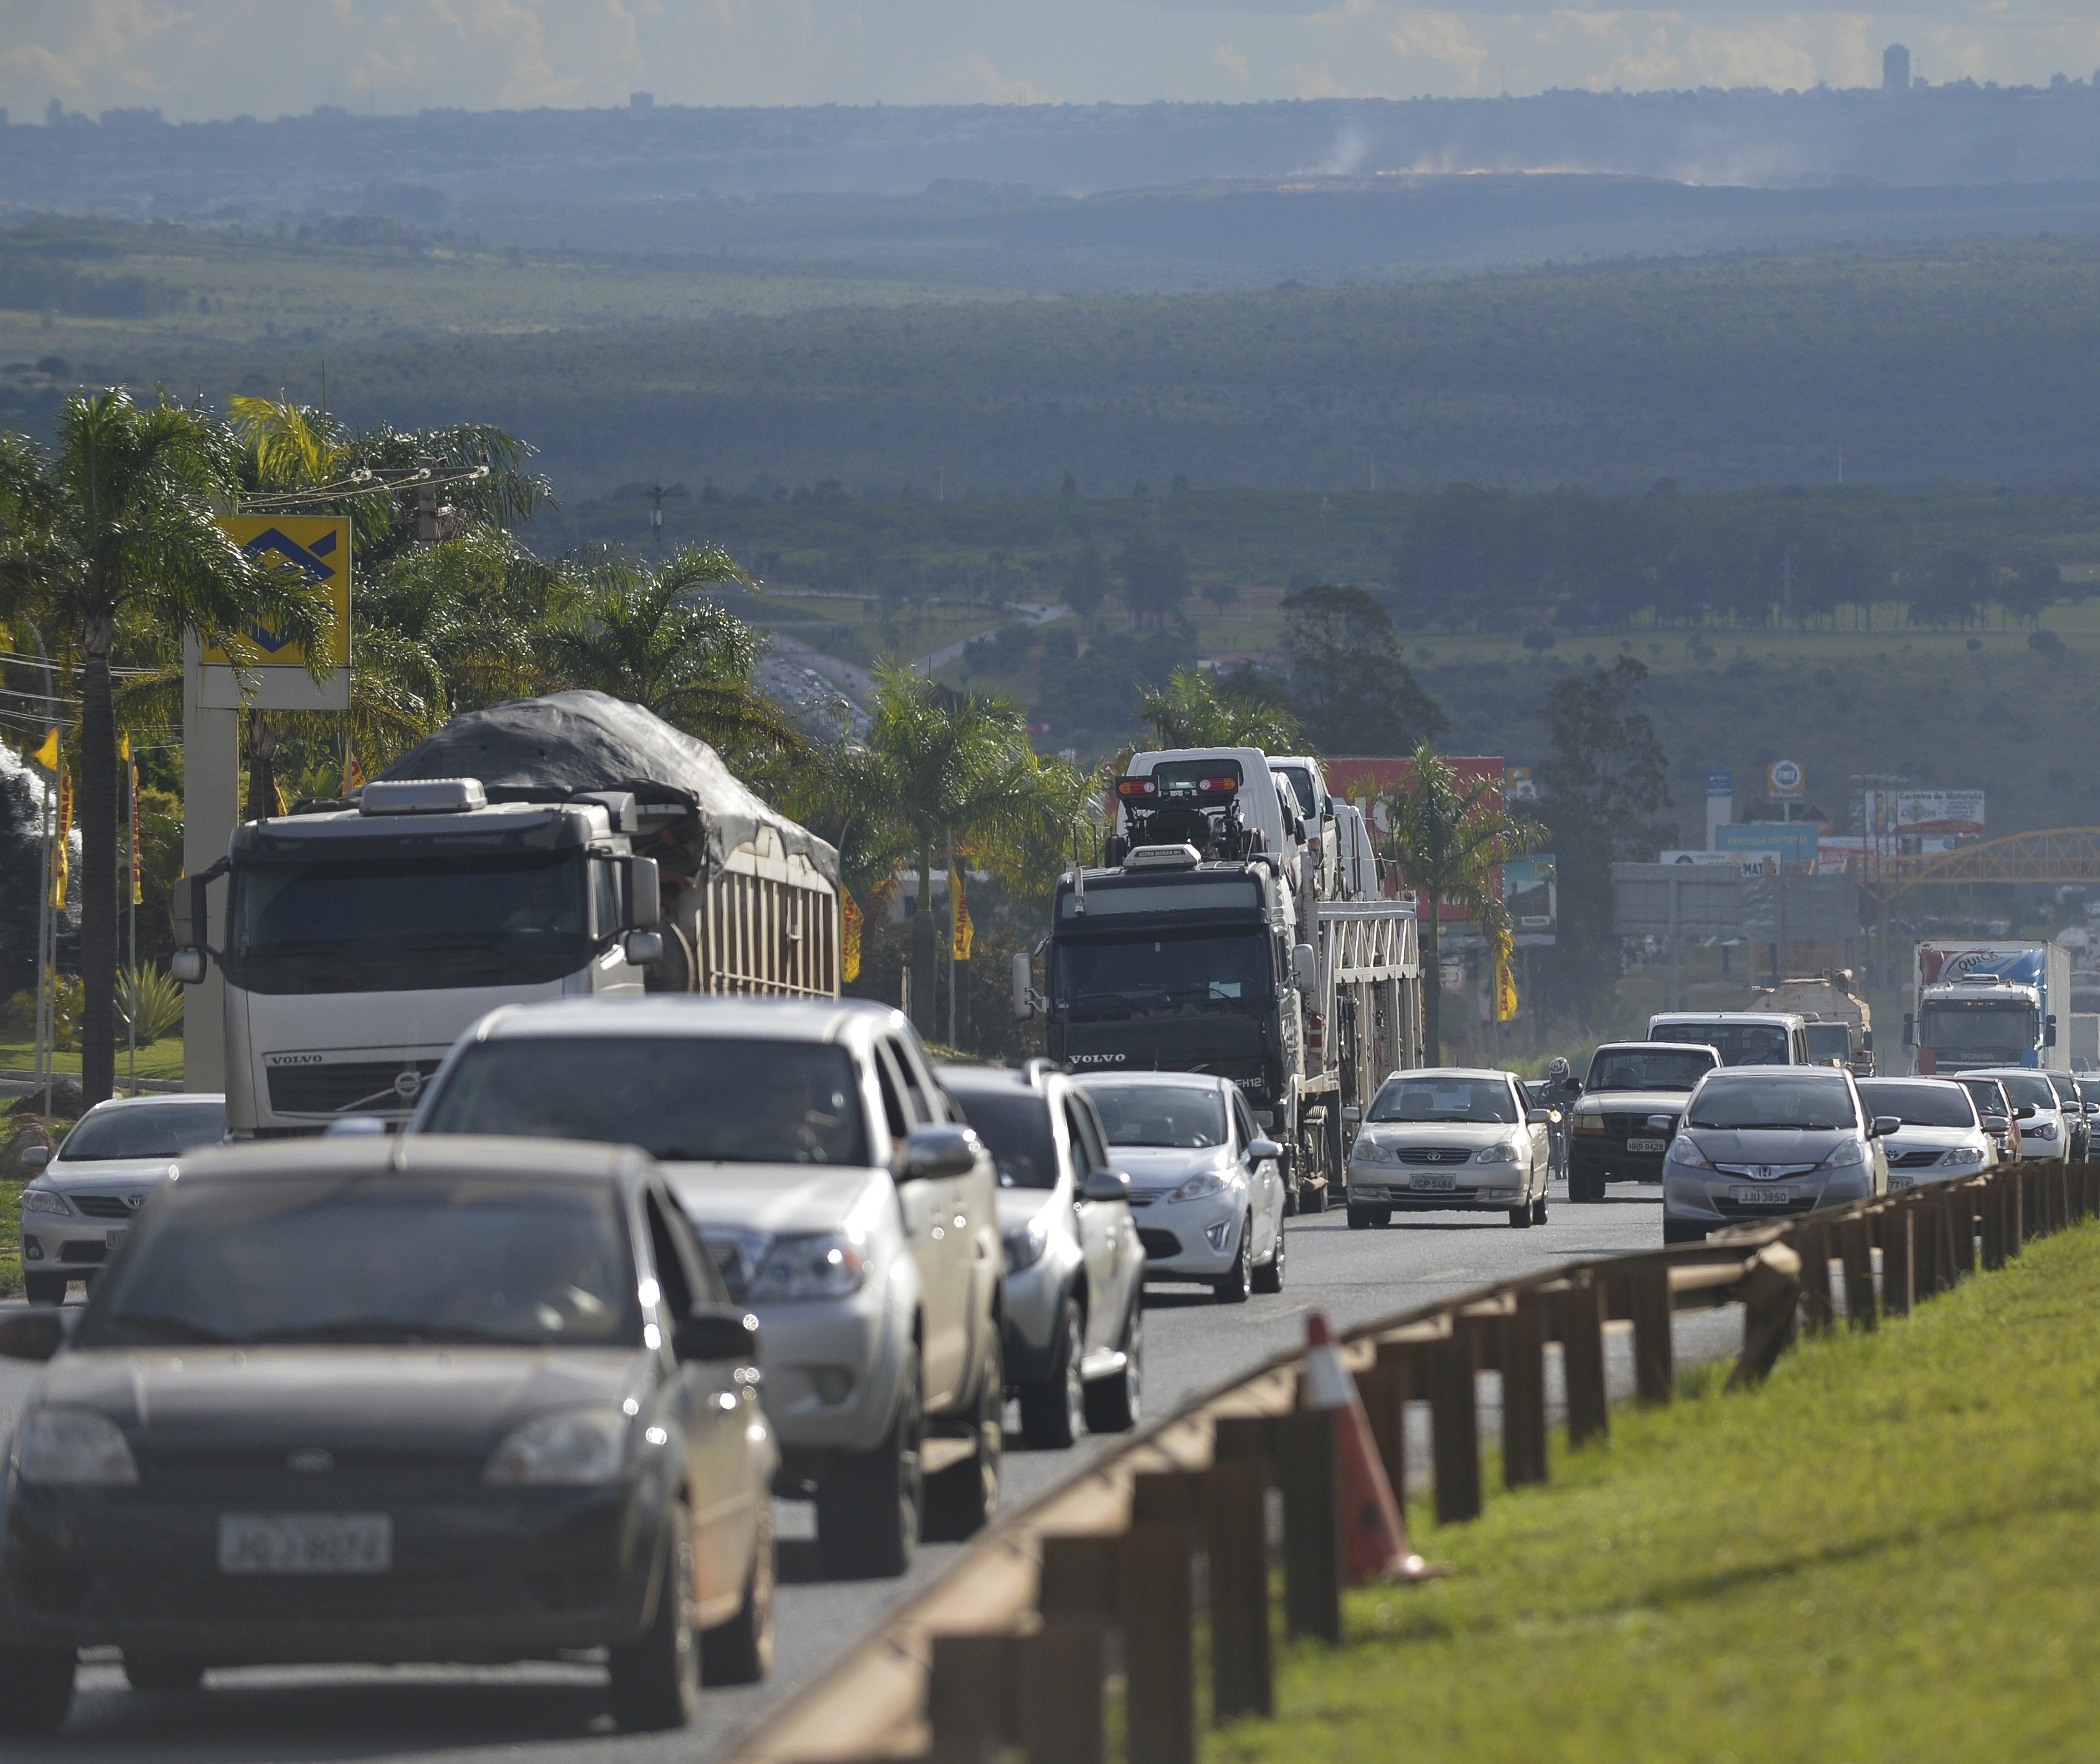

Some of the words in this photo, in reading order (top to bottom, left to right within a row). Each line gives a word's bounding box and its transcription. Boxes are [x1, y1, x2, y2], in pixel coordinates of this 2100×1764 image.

[1958, 951, 1999, 971] QUICK
[271, 1055, 323, 1064] VOLVO
[1068, 1054, 1126, 1064] VOLVO
[1235, 1078, 1262, 1088] FH12
